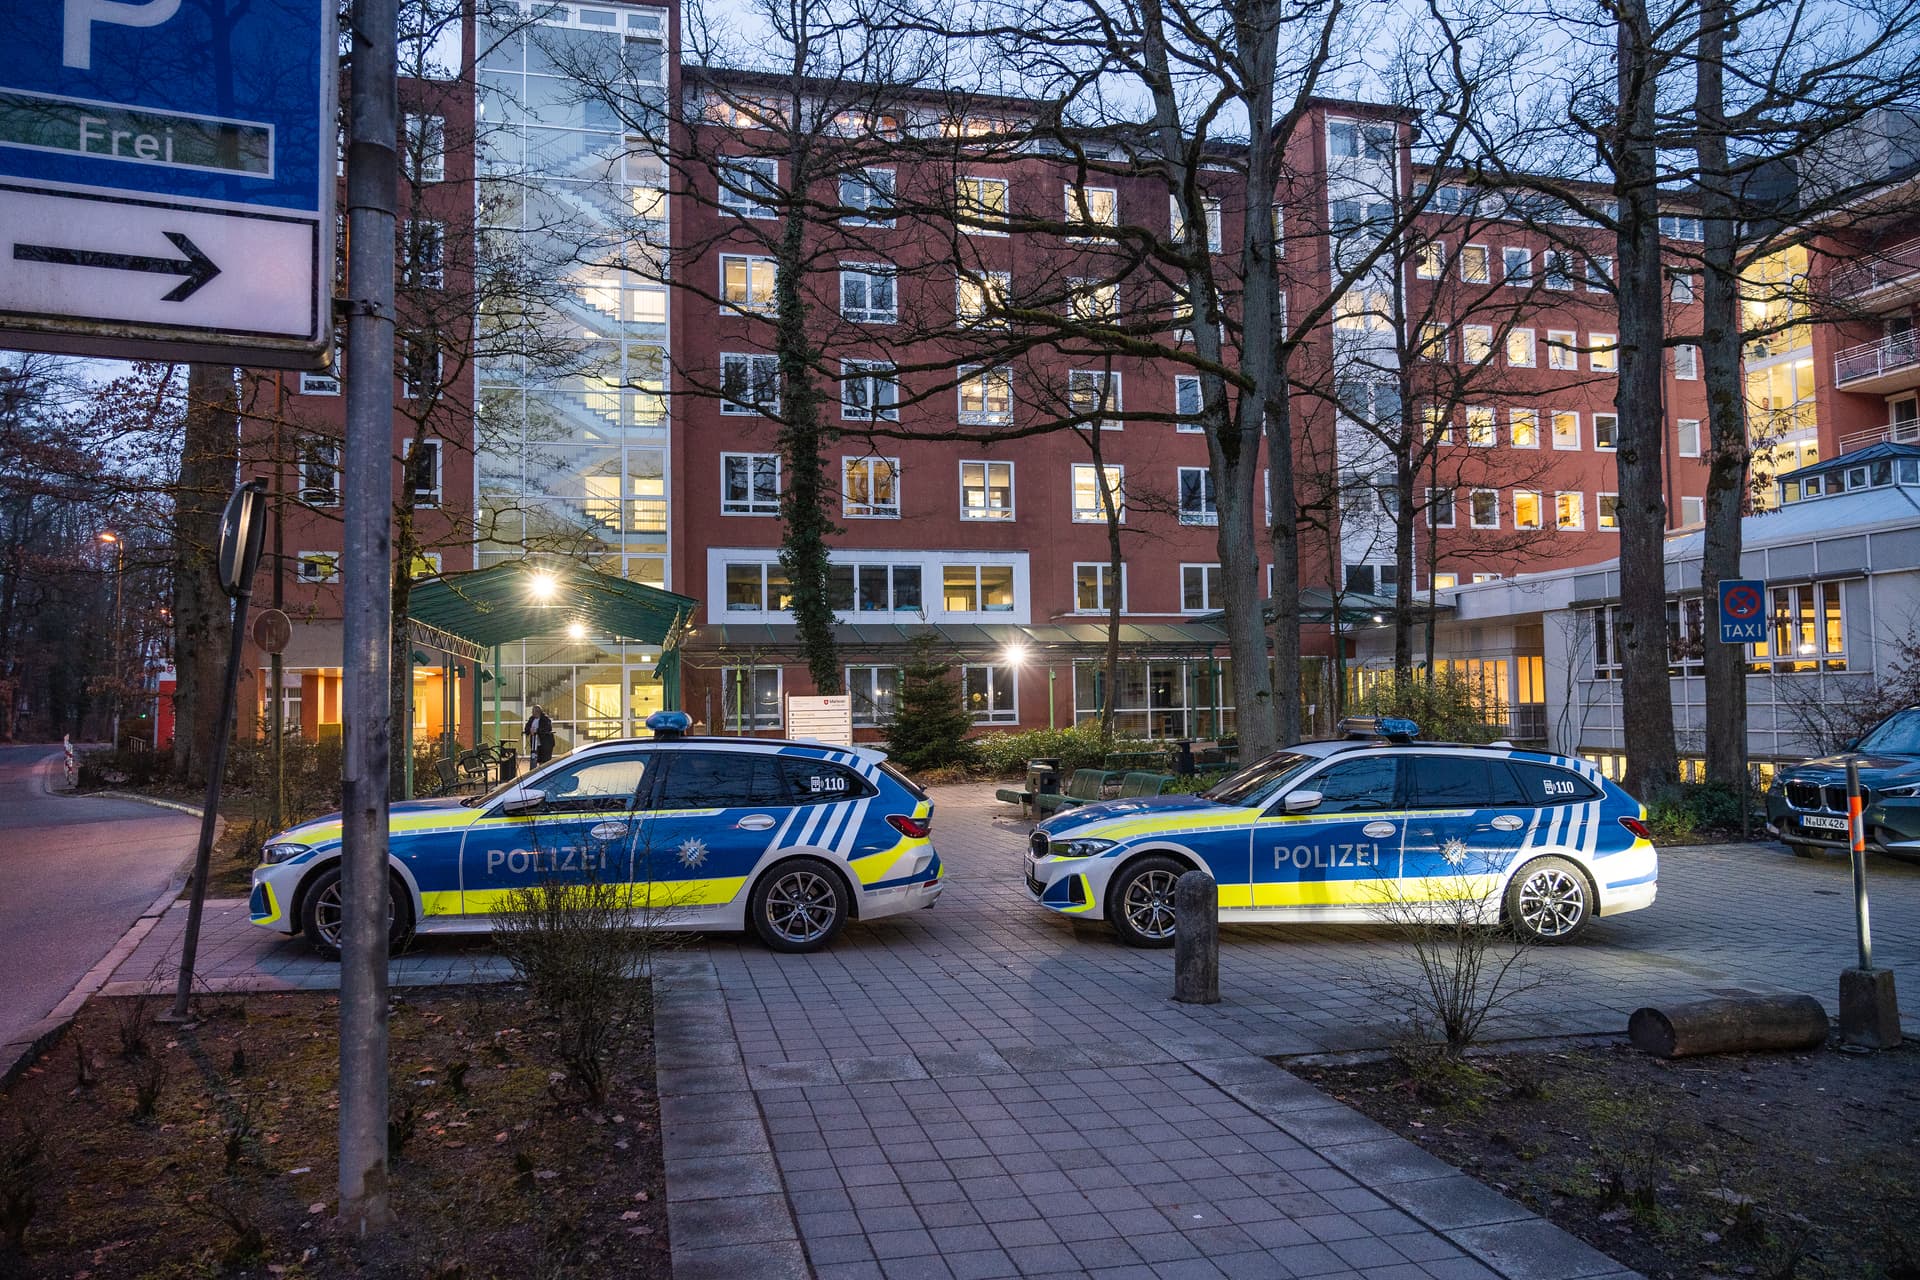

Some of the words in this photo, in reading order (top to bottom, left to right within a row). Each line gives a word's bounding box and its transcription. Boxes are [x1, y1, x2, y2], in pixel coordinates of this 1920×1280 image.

[80, 115, 173, 162] Frei
[1723, 623, 1762, 638] TAXI
[824, 777, 845, 791] 110
[1555, 781, 1575, 794] 110
[1829, 818, 1845, 829] 426
[487, 845, 606, 874] POLIZEI
[1274, 843, 1379, 869] POLIZEI
